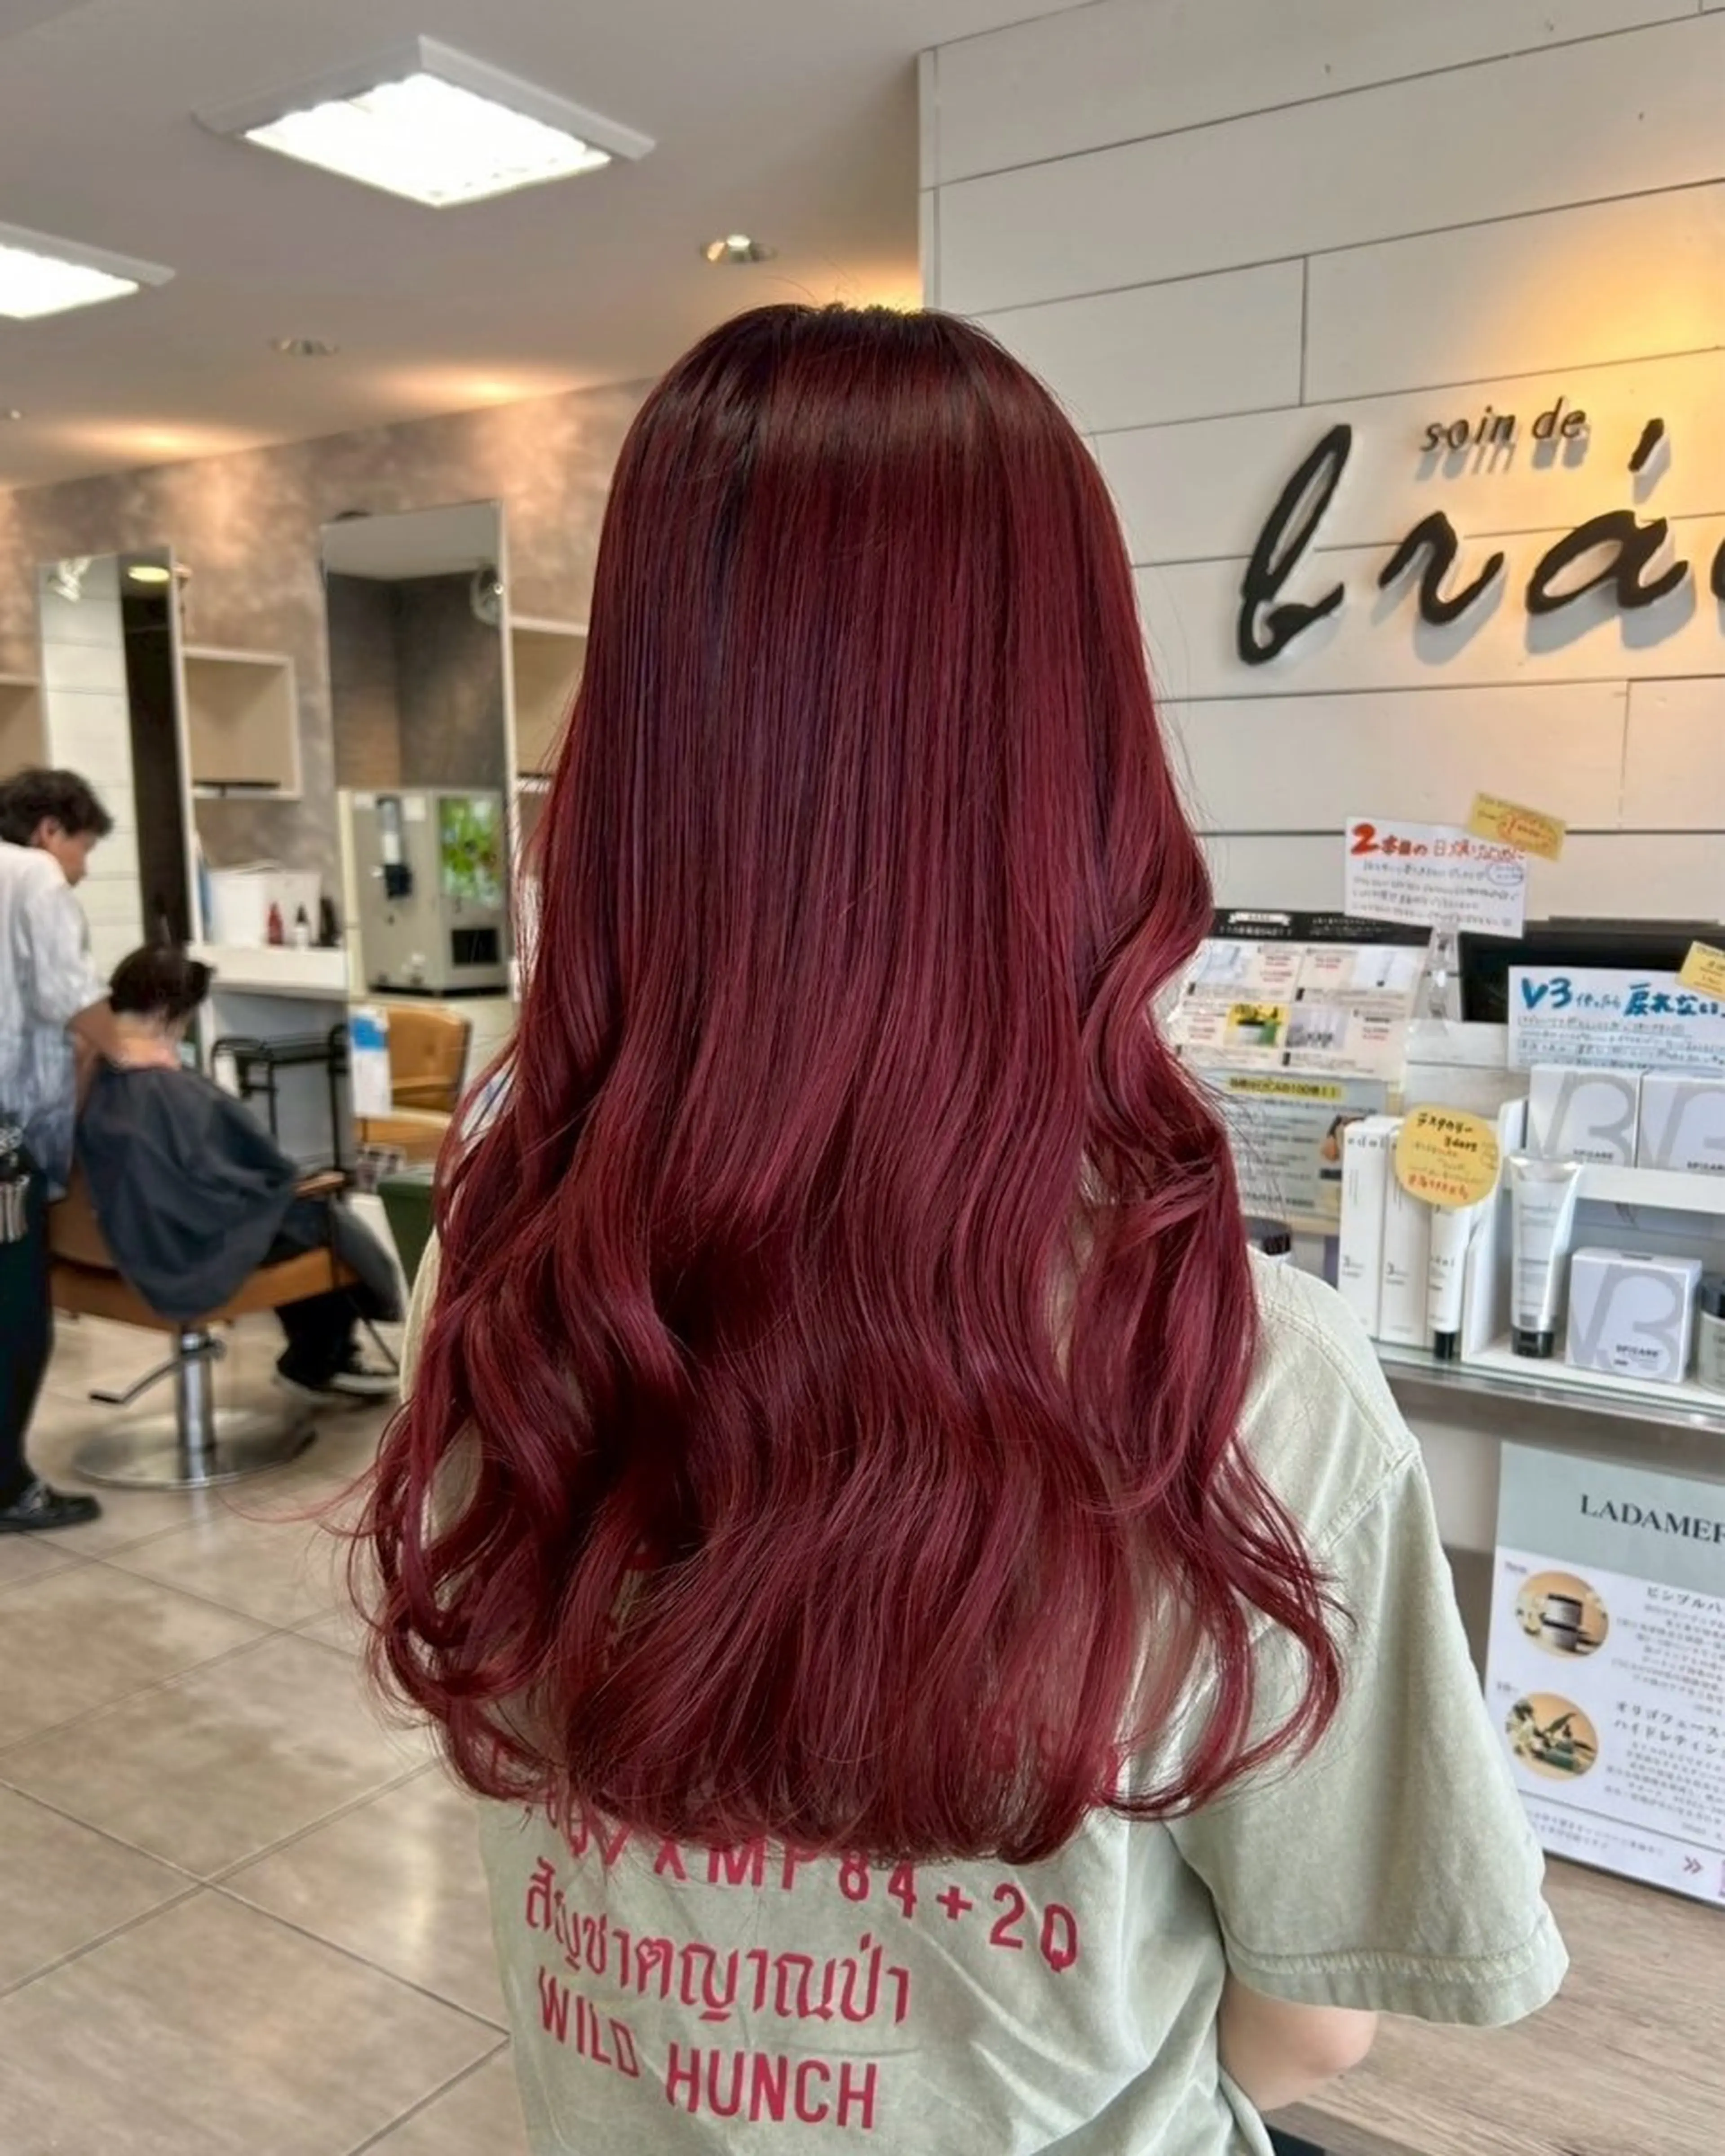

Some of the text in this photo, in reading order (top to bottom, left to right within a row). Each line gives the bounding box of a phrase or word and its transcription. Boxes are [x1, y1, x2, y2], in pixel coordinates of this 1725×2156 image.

[1420, 396, 1587, 452] soin de
[539, 1966, 877, 2129] WILD HUNCH
